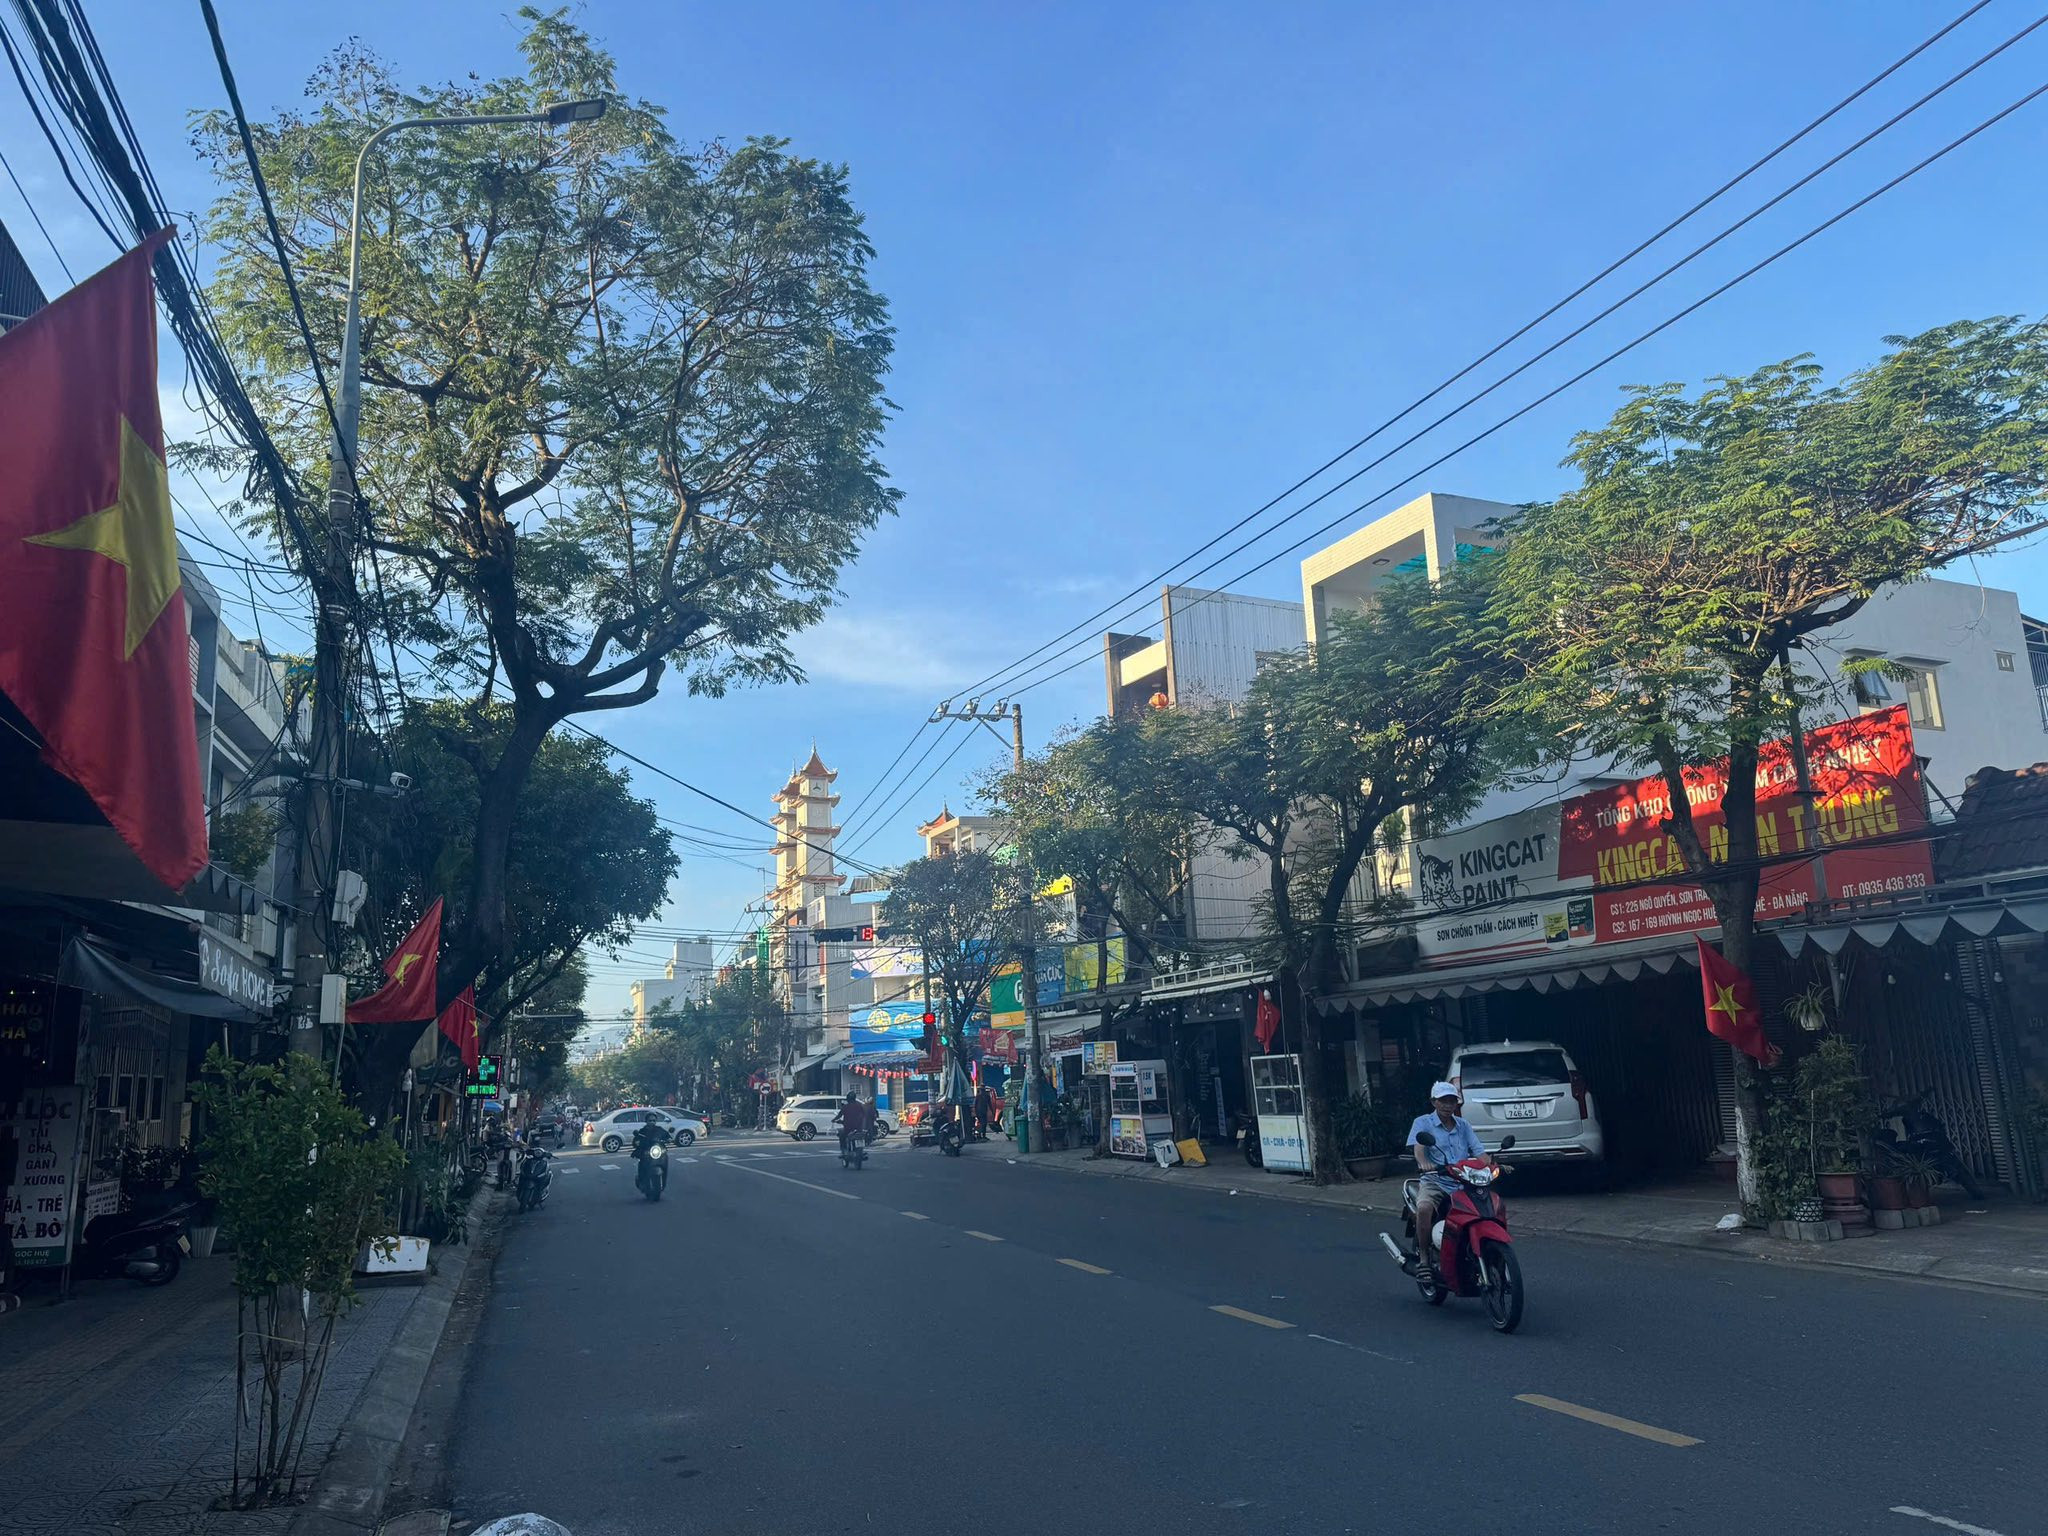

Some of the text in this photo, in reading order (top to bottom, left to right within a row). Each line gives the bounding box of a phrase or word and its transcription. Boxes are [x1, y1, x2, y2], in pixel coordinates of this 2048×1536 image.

[1595, 803, 1631, 828] TỔNG
[1633, 796, 1664, 819] KHO
[1459, 833, 1547, 879] KINGCAT
[1597, 834, 1686, 886] KINGCA
[1462, 874, 1520, 906] PAINT
[1842, 872, 1926, 898] ĐT: 0935 436 333
[1625, 901, 1639, 914] 225
[1753, 897, 1767, 913] HÊ
[1772, 893, 1785, 909] ĐÀ
[862, 927, 873, 940] 13
[1451, 923, 1473, 940] CHỐNG
[1474, 918, 1494, 935] THẤM
[1497, 915, 1517, 932] CÁCH
[1517, 912, 1539, 930] NHIỆT
[1628, 918, 1642, 932] 167
[1658, 909, 1682, 927] HUỲNH
[1683, 910, 1703, 926] NGỌC
[242, 967, 266, 1007] HOME
[3, 1194, 22, 1213] HẢ
[38, 1194, 63, 1212] TRÉ
[35, 1217, 62, 1238] BÒ
